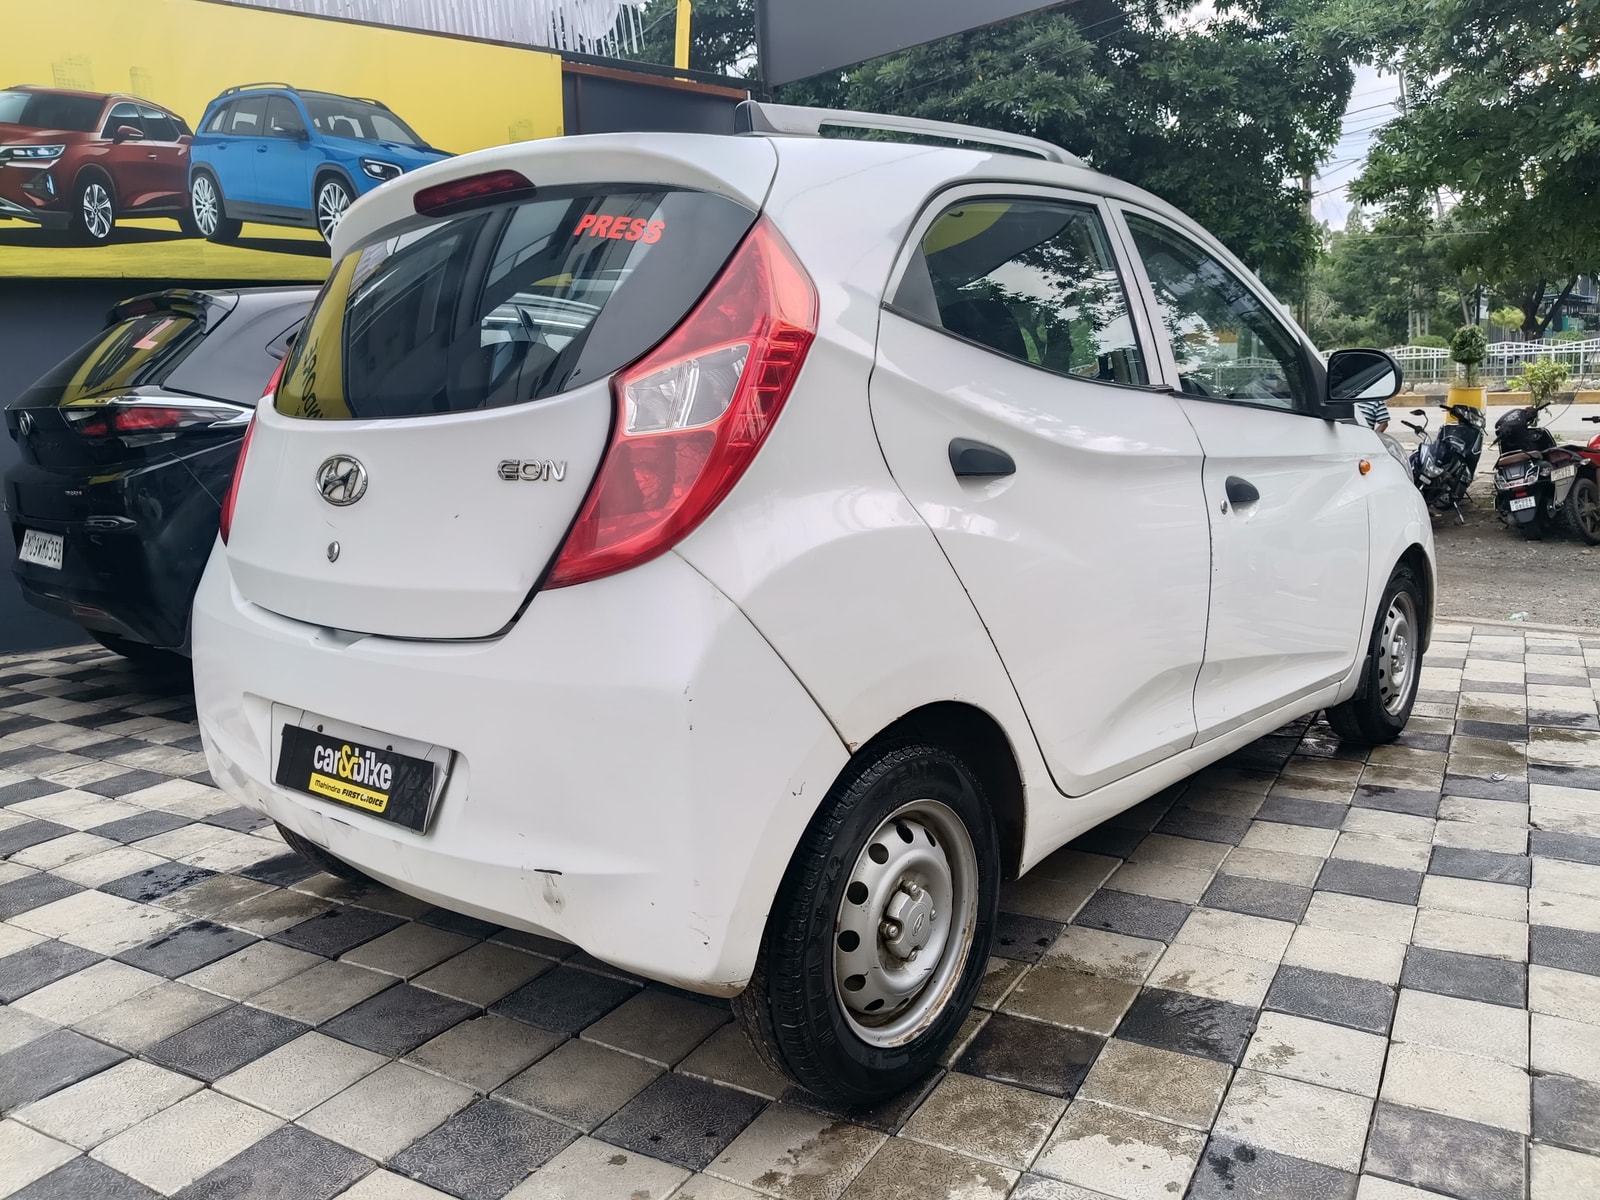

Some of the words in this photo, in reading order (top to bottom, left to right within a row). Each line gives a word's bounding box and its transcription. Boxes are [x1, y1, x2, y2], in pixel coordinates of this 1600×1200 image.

[573, 213, 666, 245] PRESS
[497, 459, 568, 482] EON
[341, 788, 361, 800] FIRST
